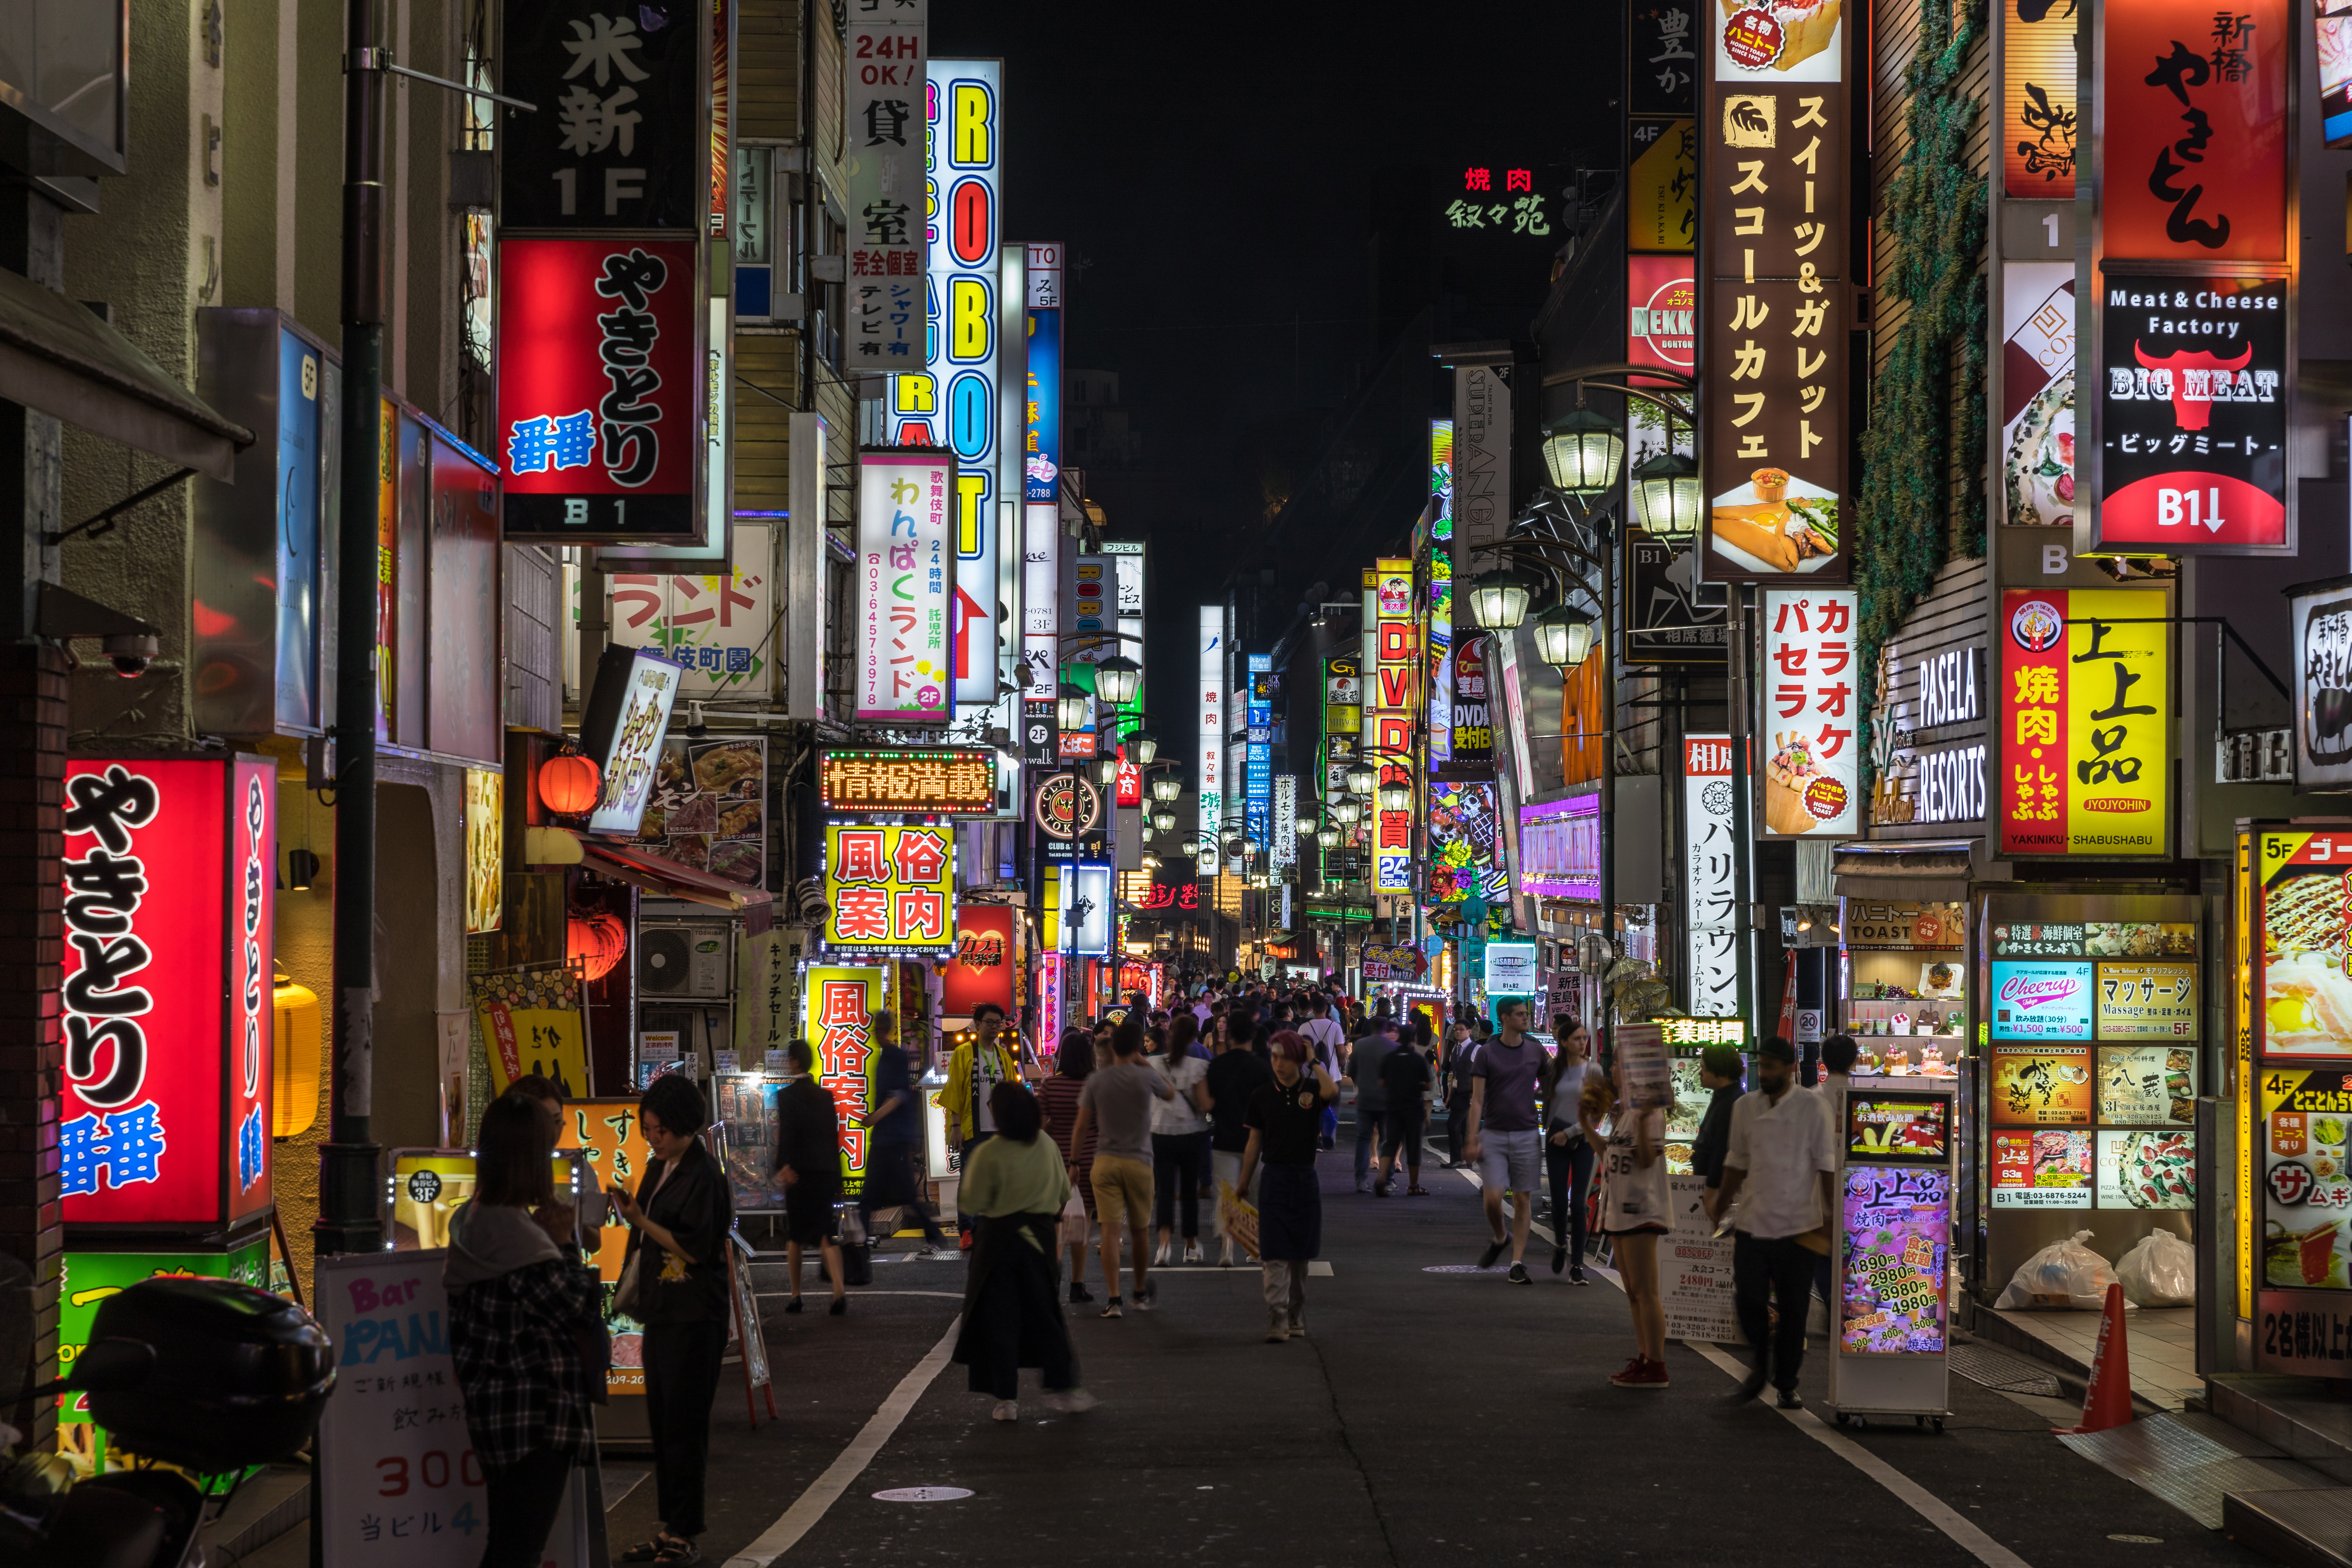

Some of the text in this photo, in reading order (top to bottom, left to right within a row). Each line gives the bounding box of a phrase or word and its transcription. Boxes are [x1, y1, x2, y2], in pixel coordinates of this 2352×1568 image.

[1744, 14, 1772, 36] 名物
[1730, 40, 1766, 58] HONEY TOAST
[1732, 47, 1760, 62] SINCE 1993
[2210, 11, 2256, 85] 新橋
[861, 65, 914, 86] OK!
[558, 13, 650, 157] 米新
[1634, 127, 1658, 141] 4F
[2144, 40, 2230, 249] やきとん
[1465, 167, 1531, 191] 焼肉
[1445, 194, 1550, 235] 叙々苑
[853, 251, 918, 277] 完全個室
[1039, 296, 1057, 306] 5F
[2110, 290, 2278, 309] Meat & Cheese
[1729, 160, 1769, 458] スコールカフェ
[859, 286, 882, 355] テレビ有
[887, 284, 911, 356] シャワー有
[2149, 317, 2239, 338] Factory
[595, 248, 668, 488] やきとり
[1499, 368, 1509, 378] 2F
[2109, 367, 2278, 402] BIG MEAT
[930, 471, 943, 524] 歌舞伎町
[2158, 488, 2199, 526] B1
[1640, 550, 1661, 563] B1
[929, 540, 942, 594] 24時間
[889, 478, 920, 698] わんぱくランド
[928, 609, 941, 649] 託児所
[1034, 619, 1051, 629] 3F
[2318, 614, 2349, 646] 新橋
[1773, 599, 1808, 718] パセラ
[1260, 675, 1280, 684] BLACK
[1816, 599, 1851, 759] カラオケ
[1920, 647, 1976, 726] PASELA
[921, 691, 937, 703] 2F
[1035, 685, 1052, 694] 2F
[1267, 685, 1279, 693] SUN
[1330, 690, 1359, 702] 蒙古苑
[1206, 691, 1217, 724] 焼肉
[1032, 729, 1045, 740] 2F
[1060, 738, 1092, 753] たばこ
[1206, 751, 1215, 783] 叙々苑
[830, 762, 988, 799] 情報満載
[1814, 781, 1843, 794] パセラ名物
[1921, 745, 1986, 823] RESORTS
[1813, 801, 1834, 810] HONEY
[1813, 807, 1832, 816] TOAST
[2086, 799, 2146, 812] JYOJYOHIN
[1091, 841, 1100, 850] B1
[2011, 835, 2152, 845] YAKINIKU SHABUSHABU
[2266, 838, 2293, 858] 5F
[833, 830, 946, 884] 風俗
[835, 886, 944, 940] 案内
[1852, 926, 1911, 939] TOAST
[1921, 928, 1934, 936] 名物
[958, 935, 1006, 952] カブキ
[960, 952, 1001, 967] 倶楽部
[1491, 958, 1530, 967] CASABLANCA
[1364, 963, 1389, 978] 受付
[2076, 967, 2089, 976] 4F
[2000, 976, 2082, 1001] Cheerup
[2102, 977, 2191, 1004] マッサージ
[2103, 1004, 2144, 1018] Massage
[1802, 1016, 1815, 1027] 20
[2173, 1022, 2191, 1035] 5F
[818, 980, 873, 1170] 風俗案内
[2267, 1074, 2294, 1095] 4F
[2105, 1100, 2121, 1112] 3F
[1857, 1113, 1914, 1123] お酒飲み放題
[2278, 1117, 2300, 1128] 各種
[2274, 1129, 2305, 1139] コース
[2278, 1139, 2299, 1150] 有り
[414, 1187, 436, 1202] 3F
[1863, 1170, 1942, 1209] 上上品
[1997, 1193, 2011, 1202] B1
[1675, 1246, 1714, 1260] 30%OFF
[1849, 1254, 1896, 1275] 1890円
[1680, 1274, 1713, 1287] 2480円
[1868, 1265, 1916, 1288] 2980円
[348, 1278, 421, 1313] Bar
[1880, 1280, 1928, 1302] 3980円
[1891, 1294, 1939, 1315] 4980円
[1844, 1312, 1887, 1332] 飲み放題
[1851, 1337, 1873, 1349] 500円
[1881, 1328, 1904, 1340] 800円
[1907, 1338, 1943, 1352] 焼き鳥
